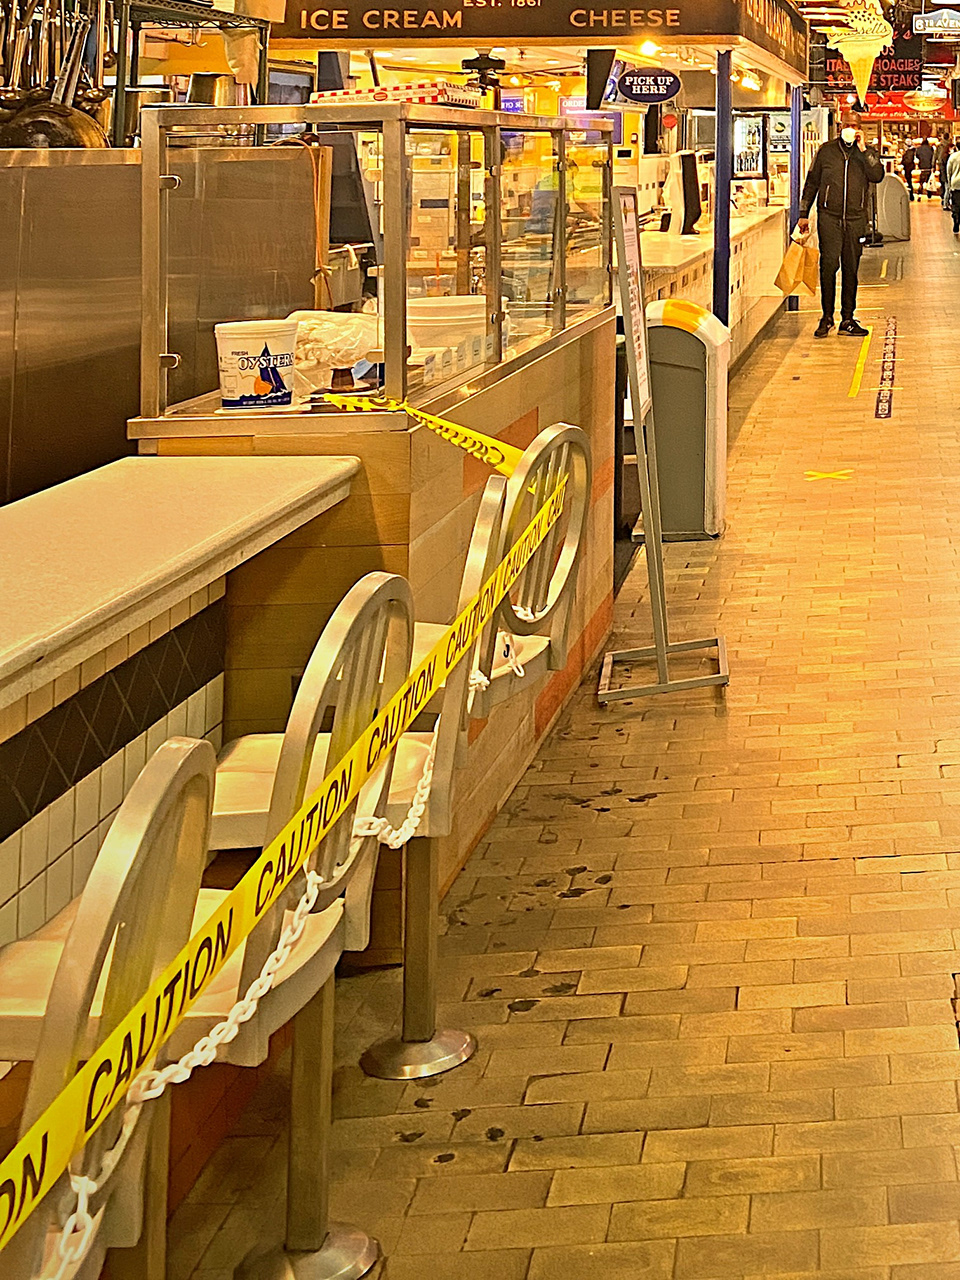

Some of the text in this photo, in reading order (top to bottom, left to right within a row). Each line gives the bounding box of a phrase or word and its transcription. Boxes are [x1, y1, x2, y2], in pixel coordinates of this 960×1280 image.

[301, 10, 463, 31] ICE CREAM
[569, 9, 681, 27] CHEESE
[625, 76, 674, 86] PICK UP
[632, 85, 667, 94] HERE
[879, 74, 920, 87] STEAKS
[502, 520, 543, 591] CAUTION
[445, 580, 497, 670] CAUTION
[366, 654, 438, 774] CAUTION
[253, 766, 353, 918] CAUTION
[84, 906, 234, 1133] CAUTION
